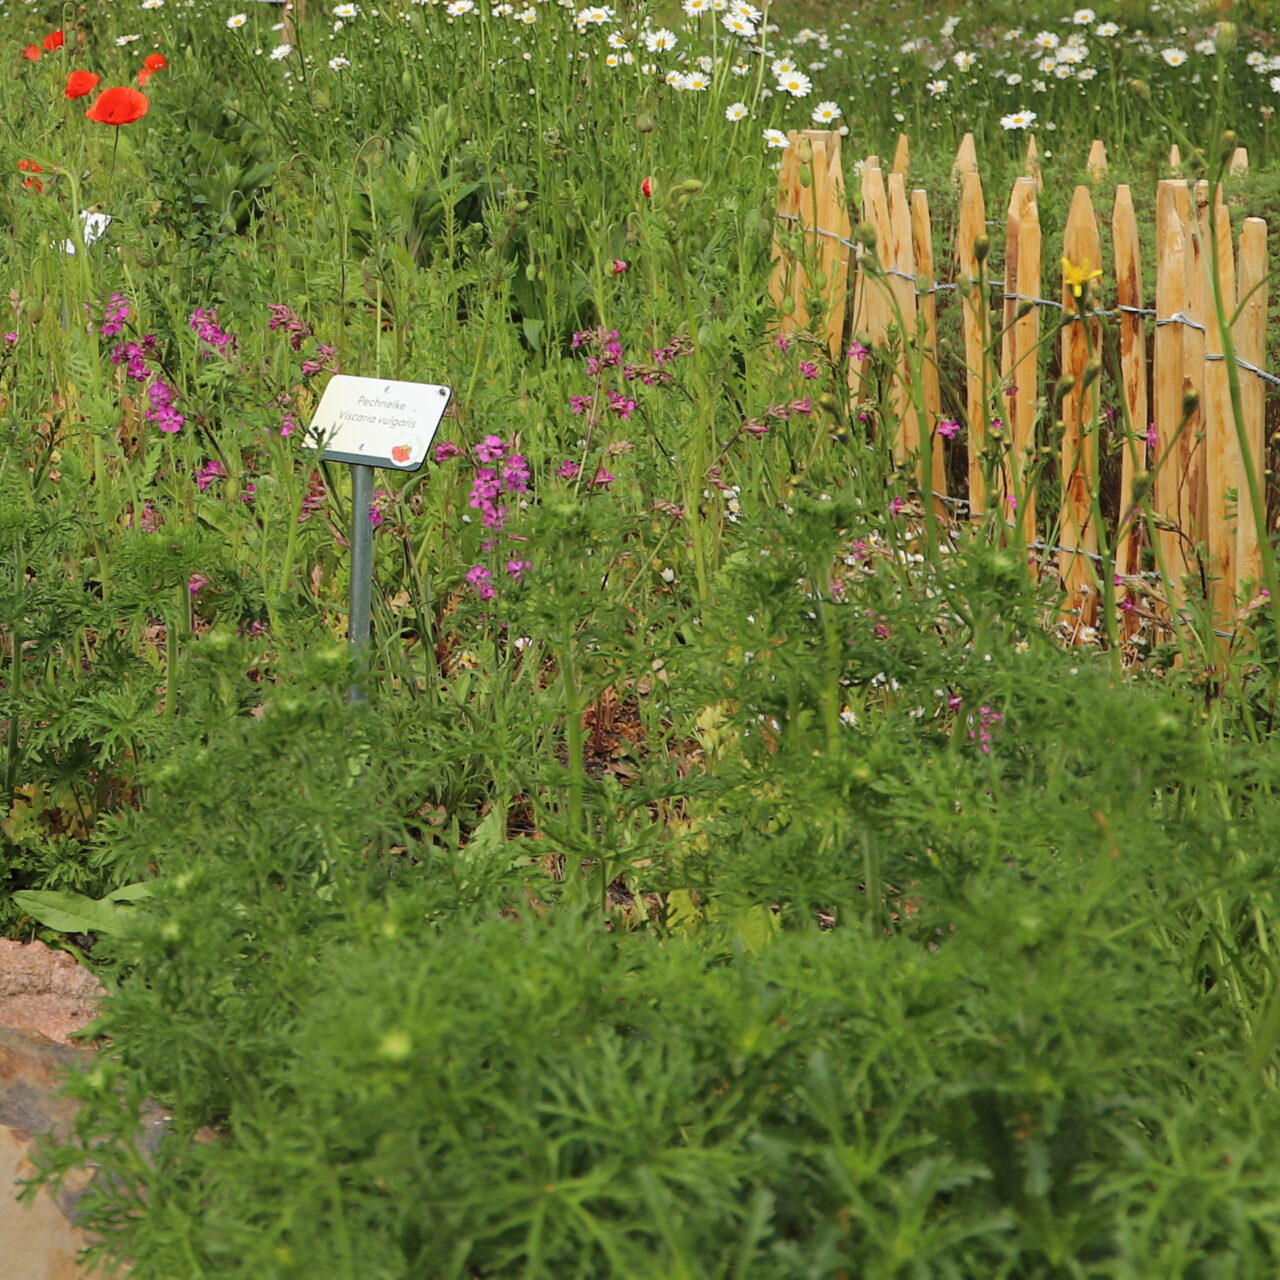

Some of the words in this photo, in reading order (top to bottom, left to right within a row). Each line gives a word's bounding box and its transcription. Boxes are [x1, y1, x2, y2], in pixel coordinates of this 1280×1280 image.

[357, 395, 406, 411] Pechnelke
[338, 410, 376, 423] Viscaria
[378, 415, 417, 429] vulgaris
